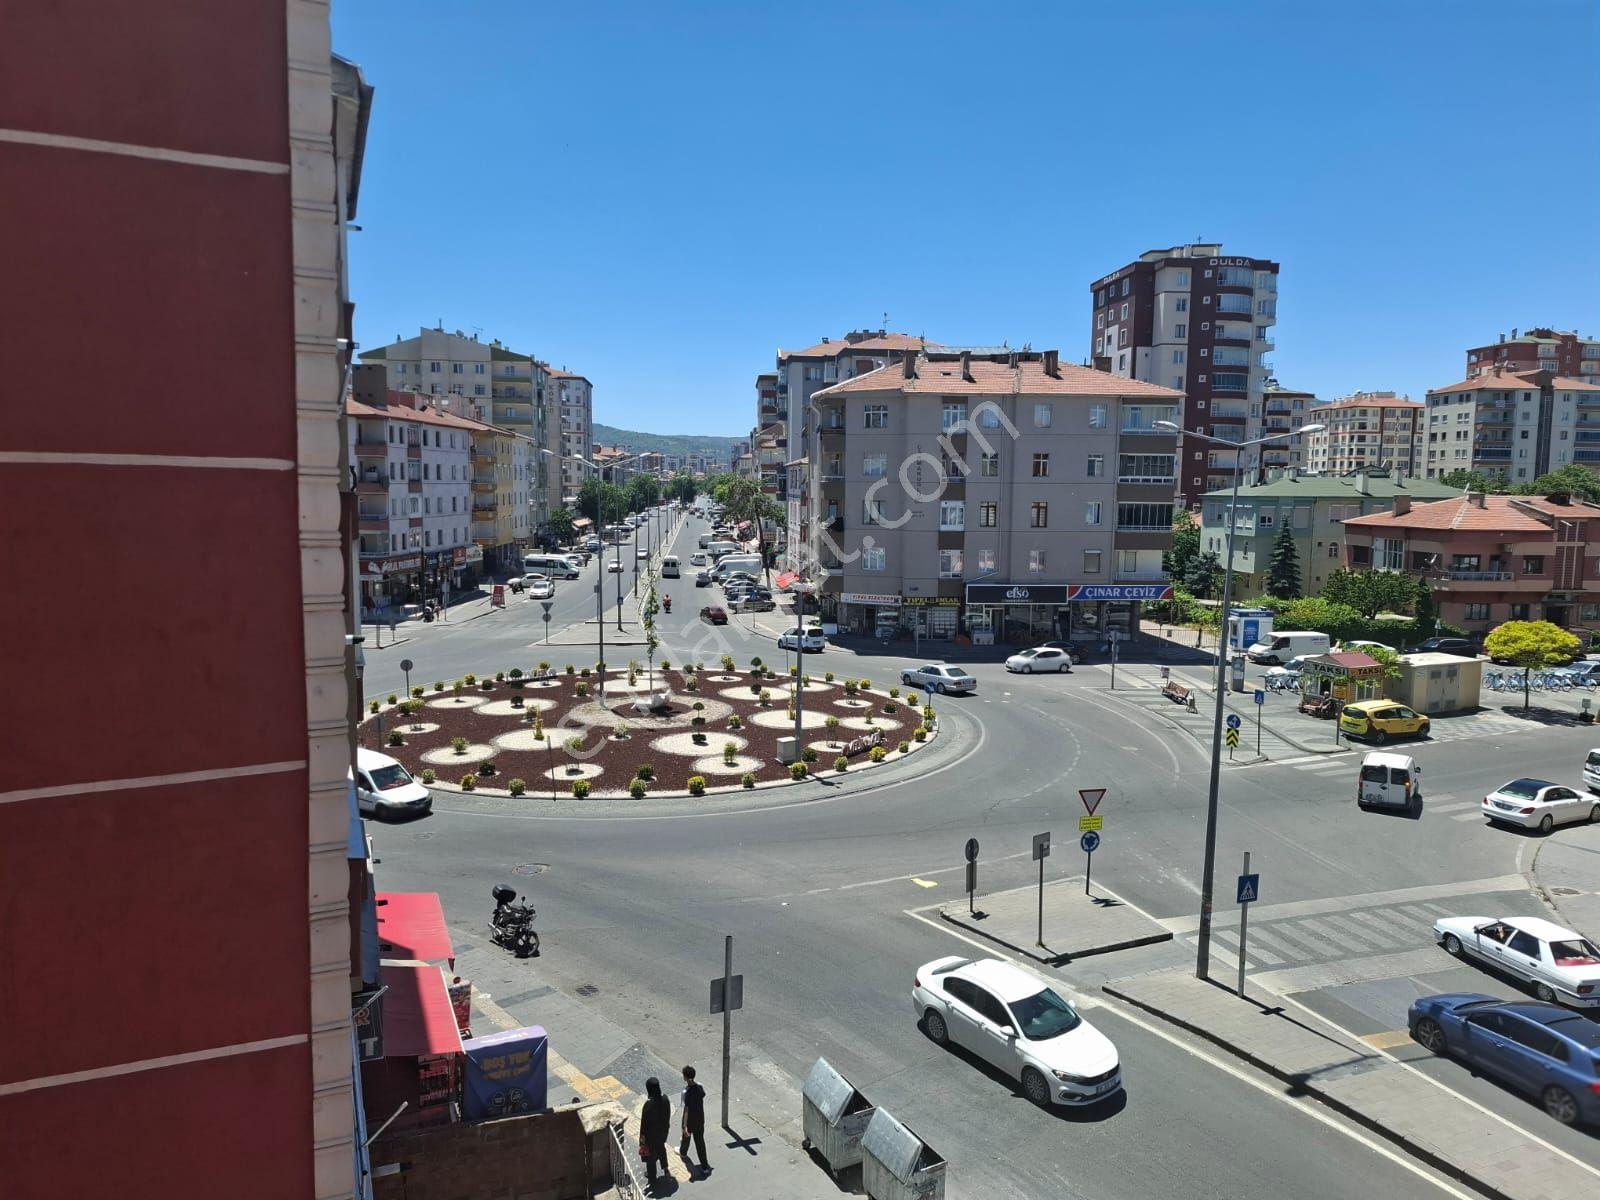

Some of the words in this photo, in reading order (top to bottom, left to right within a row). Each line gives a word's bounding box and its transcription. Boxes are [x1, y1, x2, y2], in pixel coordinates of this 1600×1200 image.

[1209, 258, 1251, 266] DULDA
[1085, 587, 1121, 599] ÇINAR
[1124, 586, 1156, 599] ÇEYİZ
